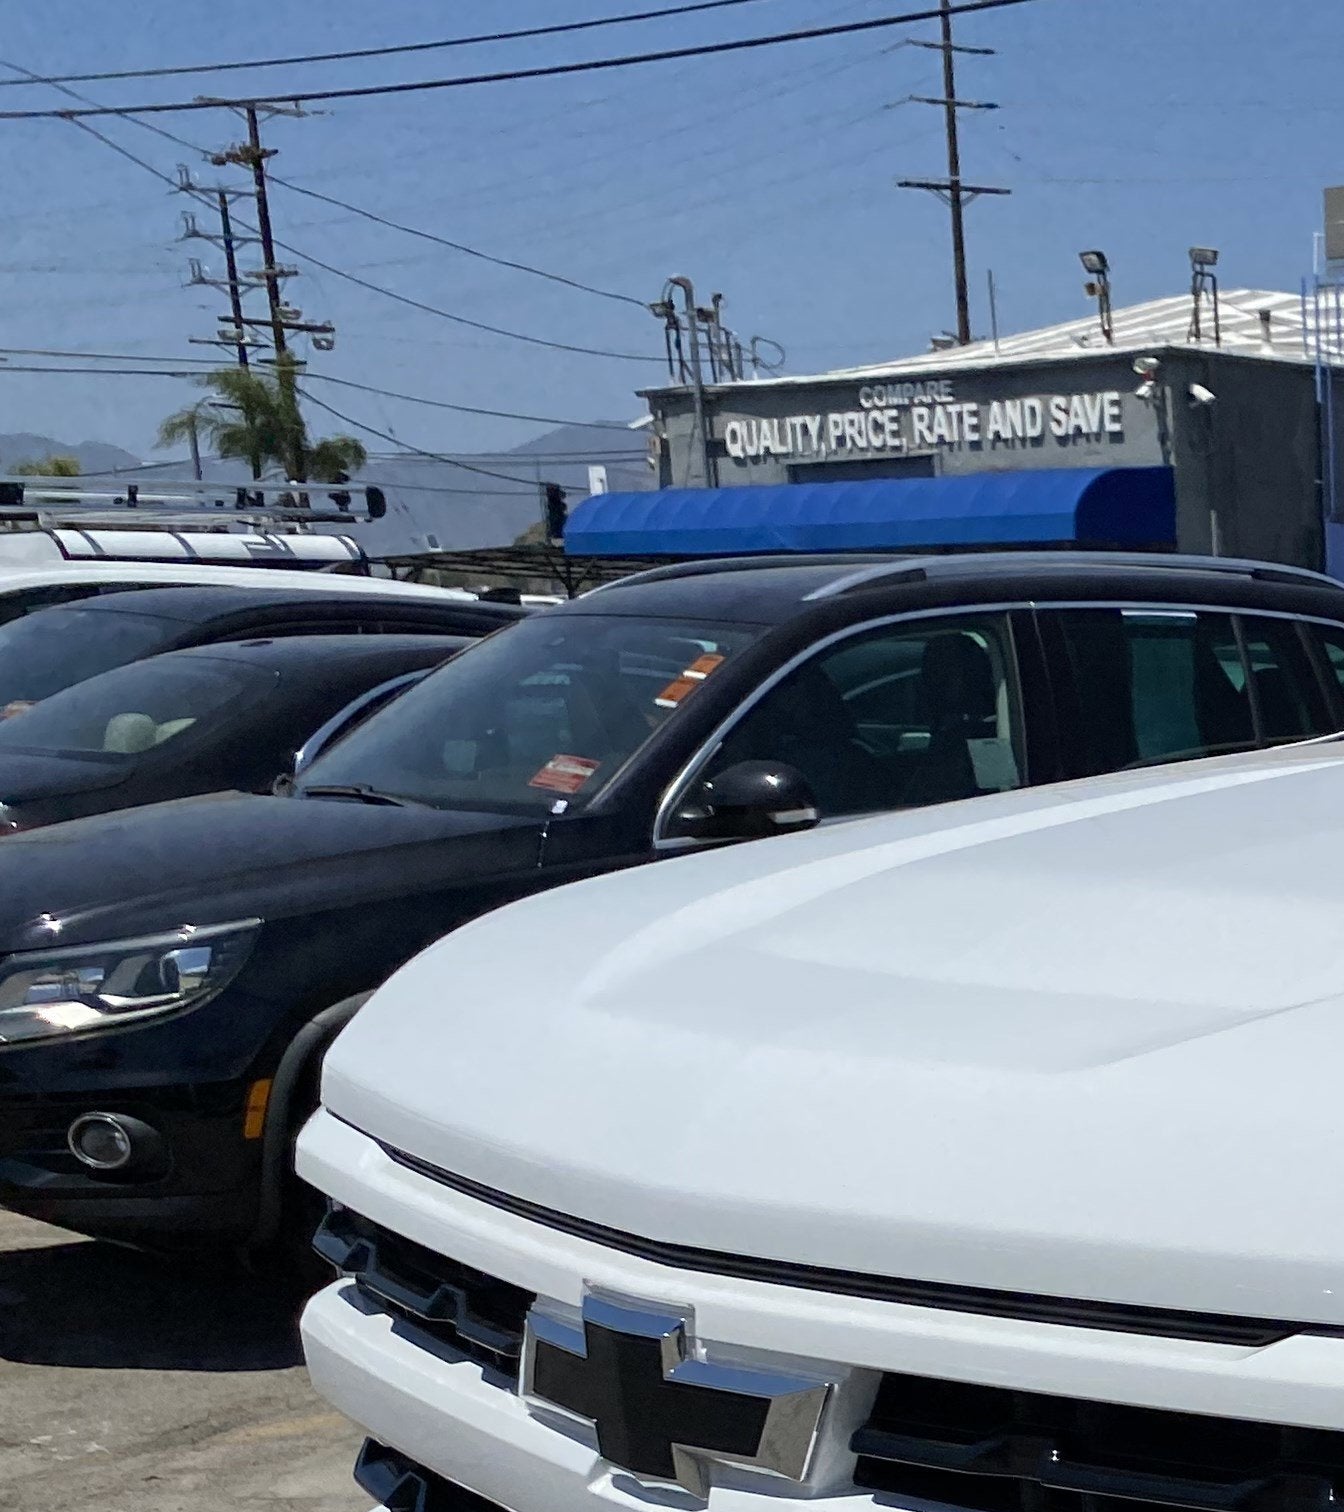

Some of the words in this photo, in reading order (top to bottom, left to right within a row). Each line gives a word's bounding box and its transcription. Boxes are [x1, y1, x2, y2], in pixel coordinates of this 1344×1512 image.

[858, 379, 955, 408] COMPARE
[724, 413, 826, 459] QUALITY,
[827, 408, 906, 450] PRICE,
[911, 402, 979, 445] RATE
[986, 399, 1043, 440] AND
[1049, 391, 1123, 437] SAVE
